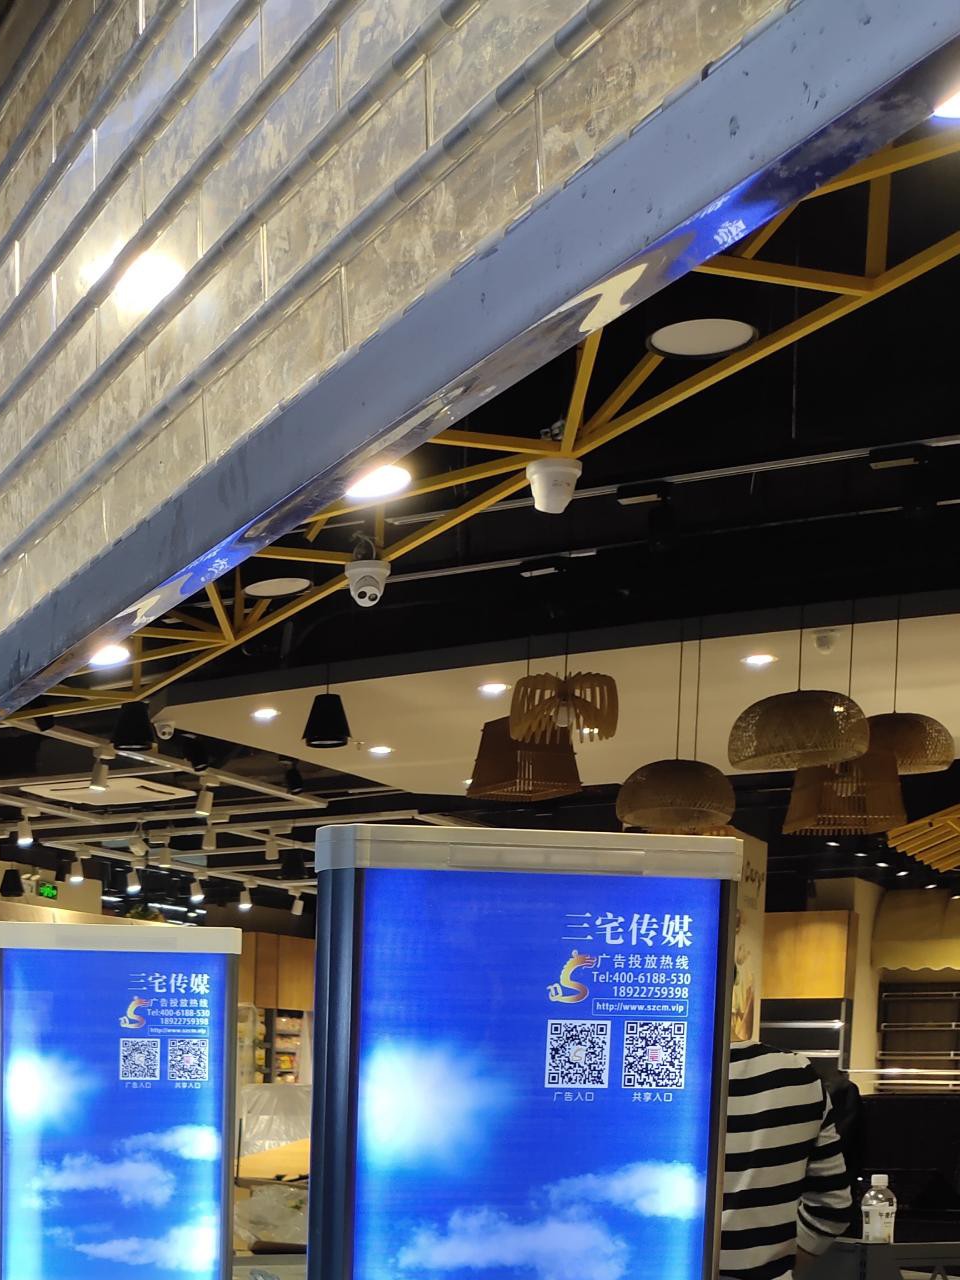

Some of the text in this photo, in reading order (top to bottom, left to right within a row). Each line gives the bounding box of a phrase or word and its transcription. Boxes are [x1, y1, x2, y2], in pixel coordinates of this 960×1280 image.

[562, 911, 694, 948] 三宅传媒
[597, 953, 691, 970] 广告投放热线
[127, 972, 210, 994] 三宅传媒
[592, 970, 692, 986] Tel:400-6188-530
[612, 985, 690, 999] 18922759398
[150, 998, 209, 1008] 广告投放热线
[596, 1001, 685, 1013] http://www.szcm.vip
[553, 1091, 595, 1103] 广告入口
[632, 1092, 673, 1103] 共享入口
